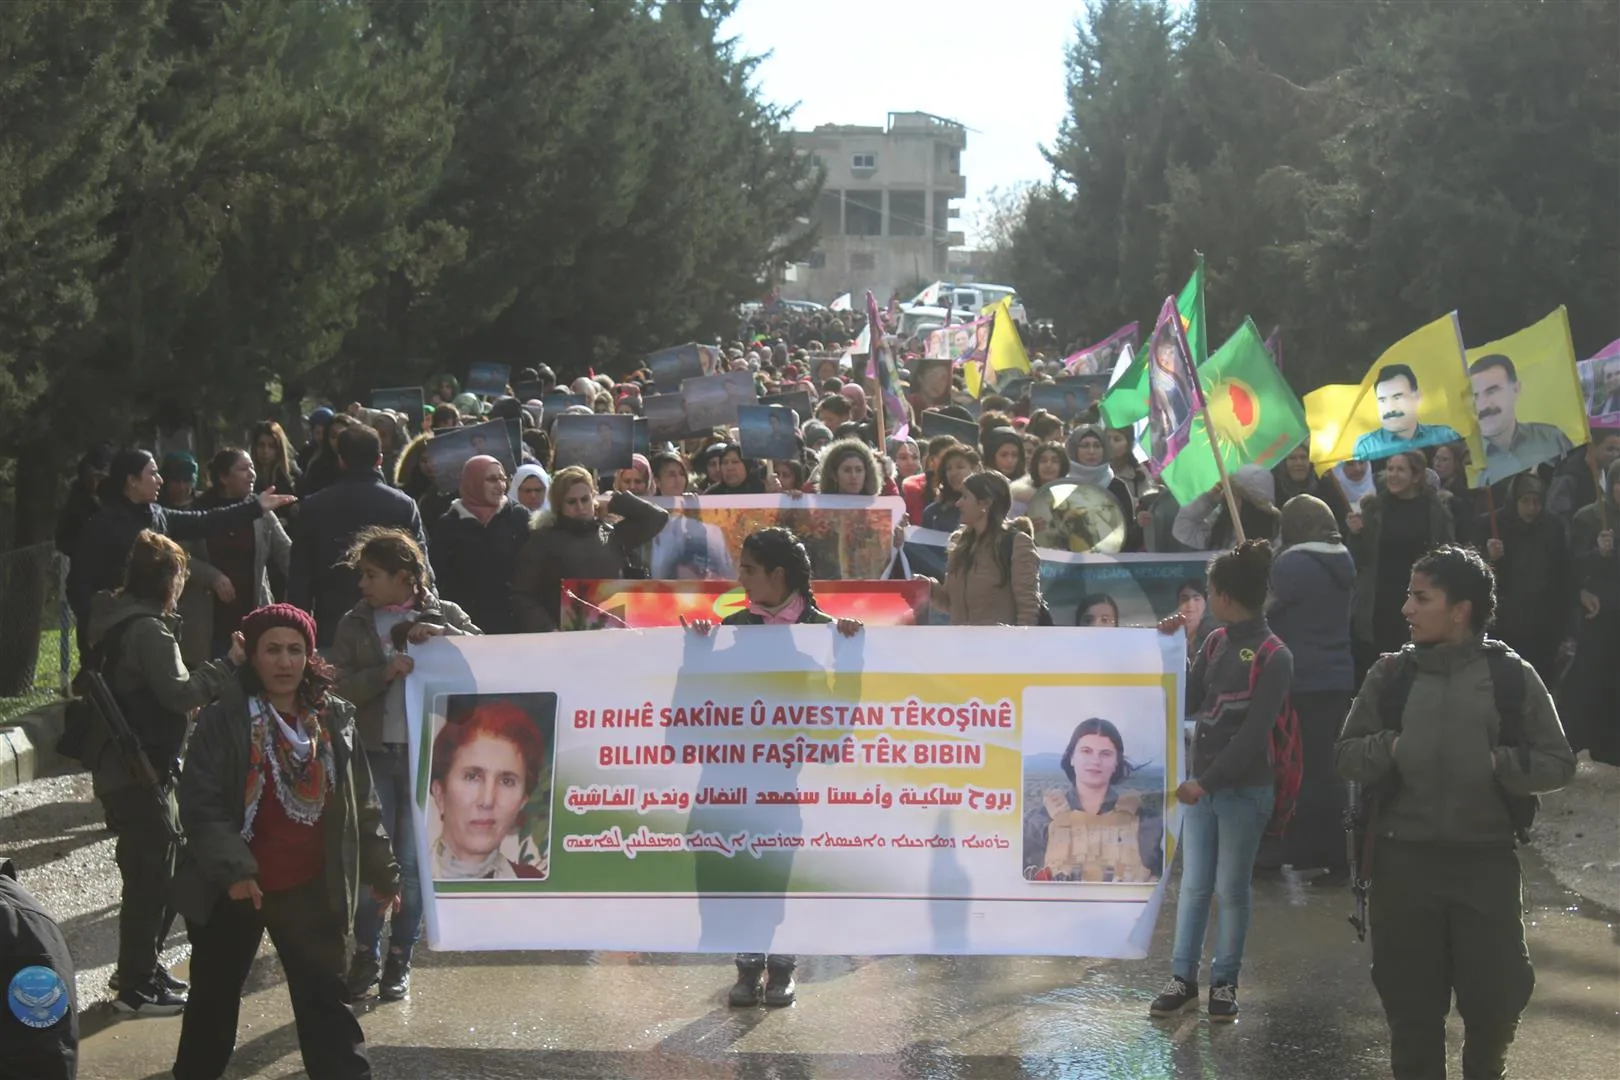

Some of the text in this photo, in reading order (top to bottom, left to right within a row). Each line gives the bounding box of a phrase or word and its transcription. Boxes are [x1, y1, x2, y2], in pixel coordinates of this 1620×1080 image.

[574, 699, 1012, 732] BI RIHÊ SAKÎNE Û AVESTAN TÊKOŞÎNÊ
[599, 736, 981, 769] BILIND BIKIN FAŞÎZMÊ TÊK BIBIN
[567, 788, 635, 810] الفاشية
[640, 788, 689, 810] وندحر
[695, 786, 747, 805] النضال
[755, 787, 820, 805] سنصعد
[899, 787, 963, 810] ساكينة
[968, 788, 1012, 811] بروح
